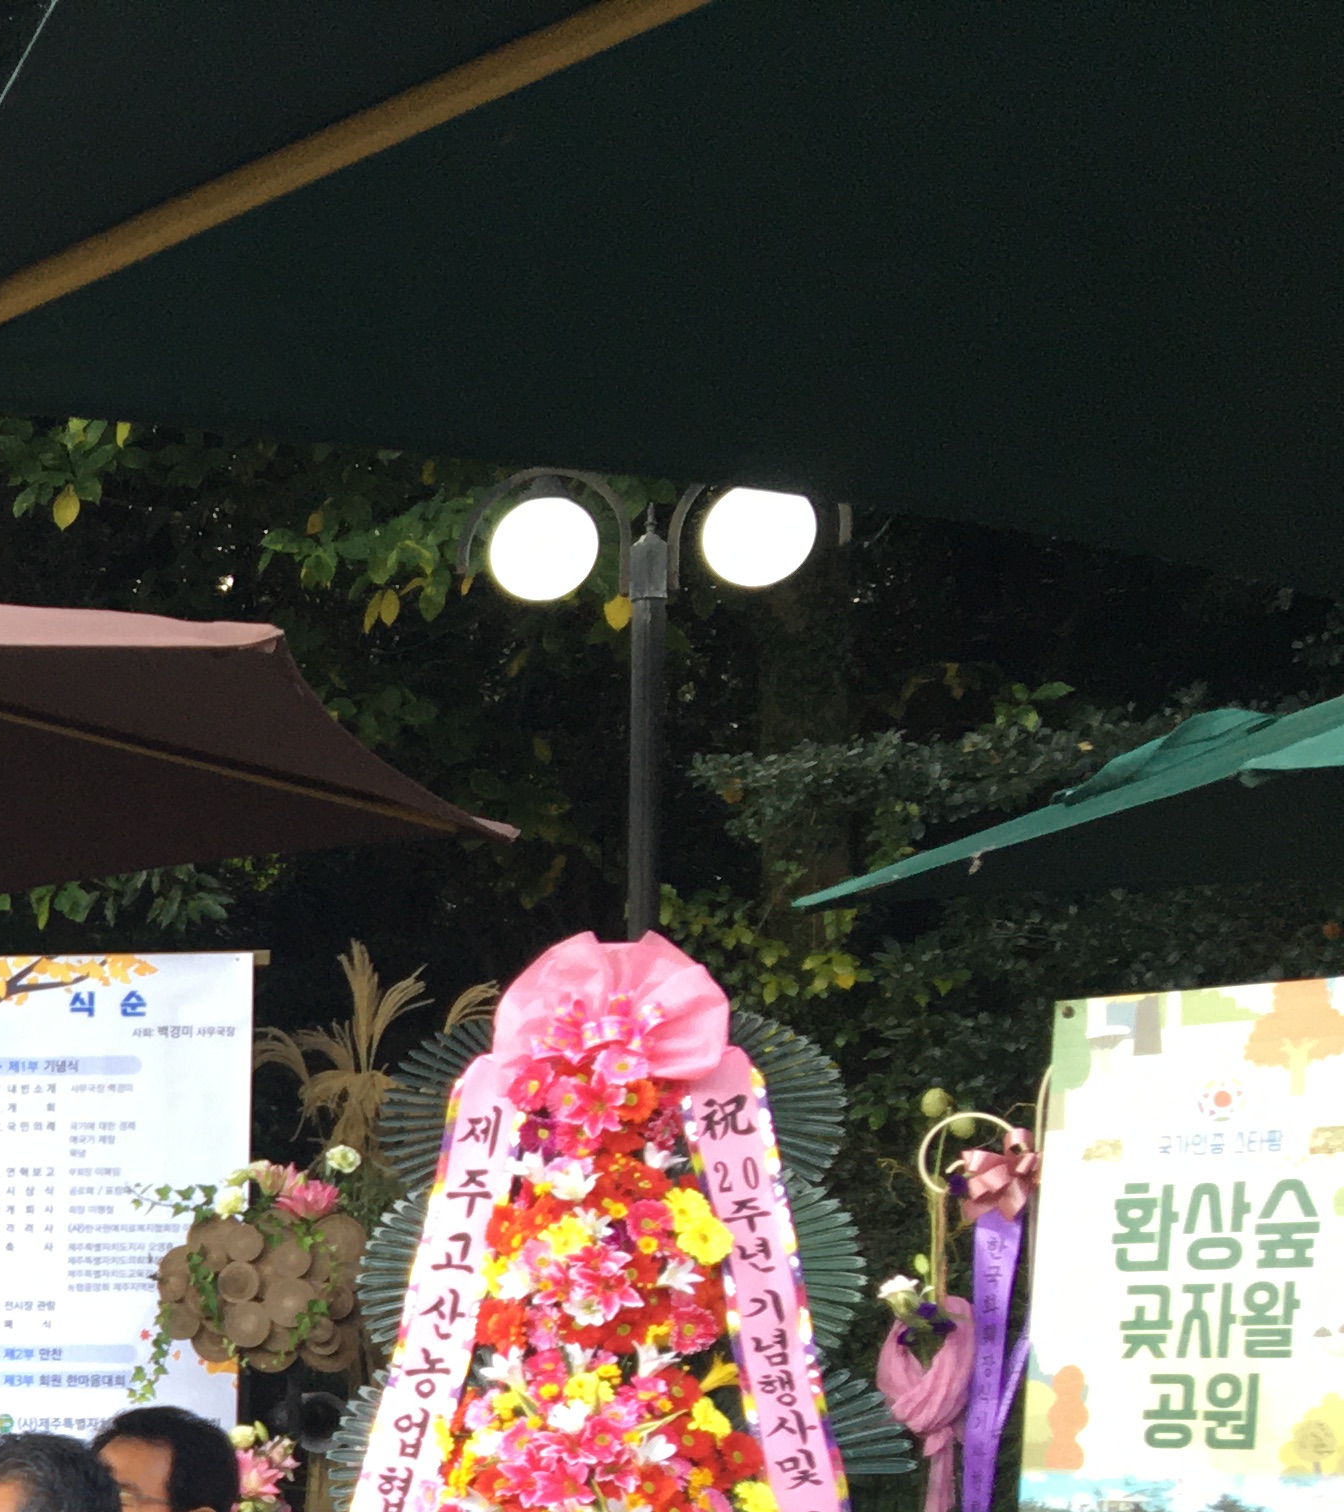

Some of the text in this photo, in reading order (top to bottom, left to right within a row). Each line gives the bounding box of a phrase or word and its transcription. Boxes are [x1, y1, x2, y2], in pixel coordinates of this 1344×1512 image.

[7, 1059, 79, 1073] 제1부 기념식
[700, 1097, 758, 1139] 祝
[713, 1155, 772, 1274] 20주년
[1111, 1178, 1320, 1272] 환상숲
[1119, 1280, 1301, 1359] 곶자왈
[3, 1348, 62, 1361] 제2부 만찬
[3, 1374, 126, 1388] 제3부 회원 한마음대회
[1142, 1372, 1260, 1450] 공원
